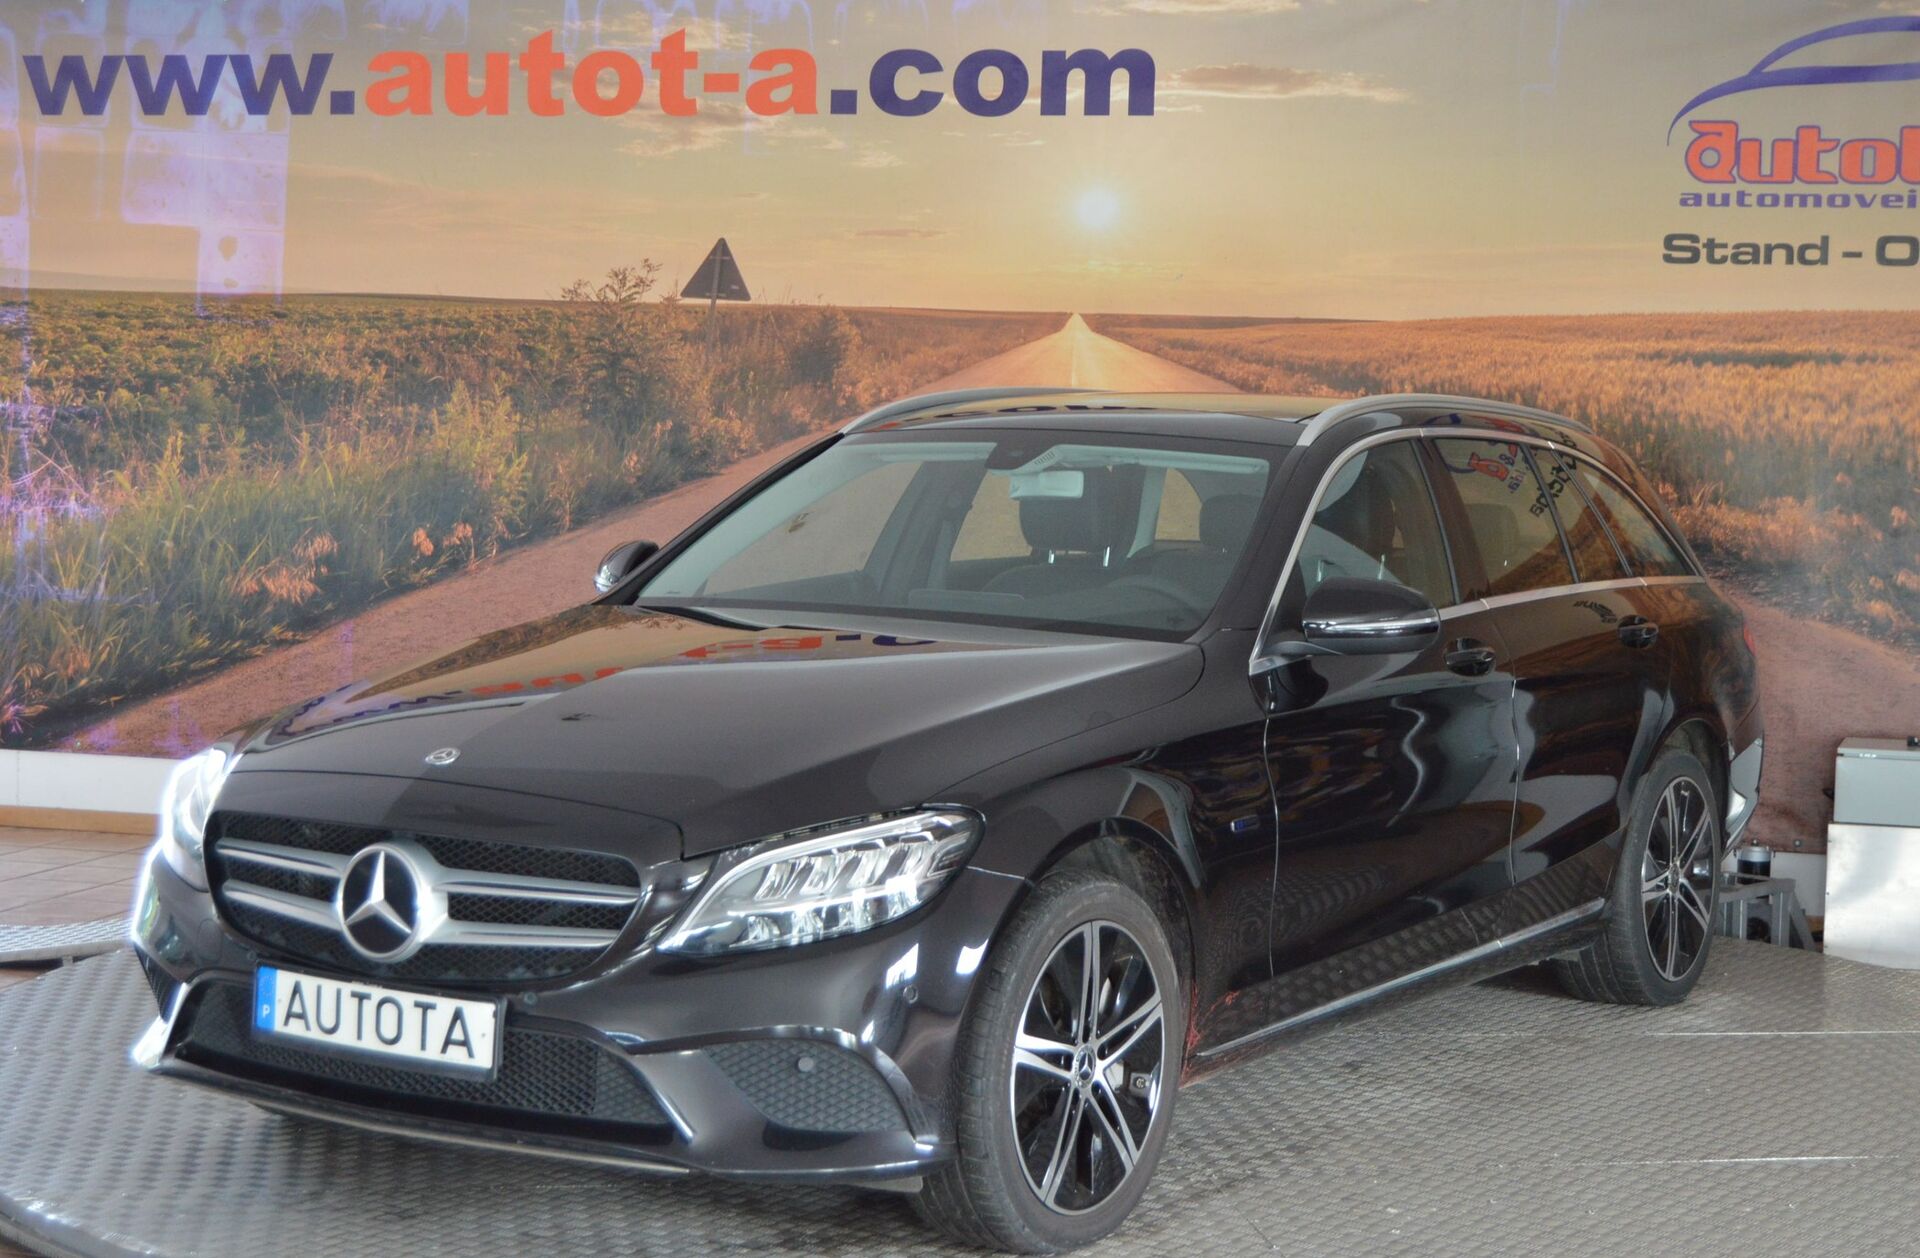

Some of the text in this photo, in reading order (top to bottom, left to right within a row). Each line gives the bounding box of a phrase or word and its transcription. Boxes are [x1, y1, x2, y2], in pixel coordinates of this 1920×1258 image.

[23, 28, 1156, 117] www.autot-a.com
[1661, 232, 1830, 267] Stand
[261, 1004, 270, 1018] P
[283, 980, 475, 1059] AUTOTA
